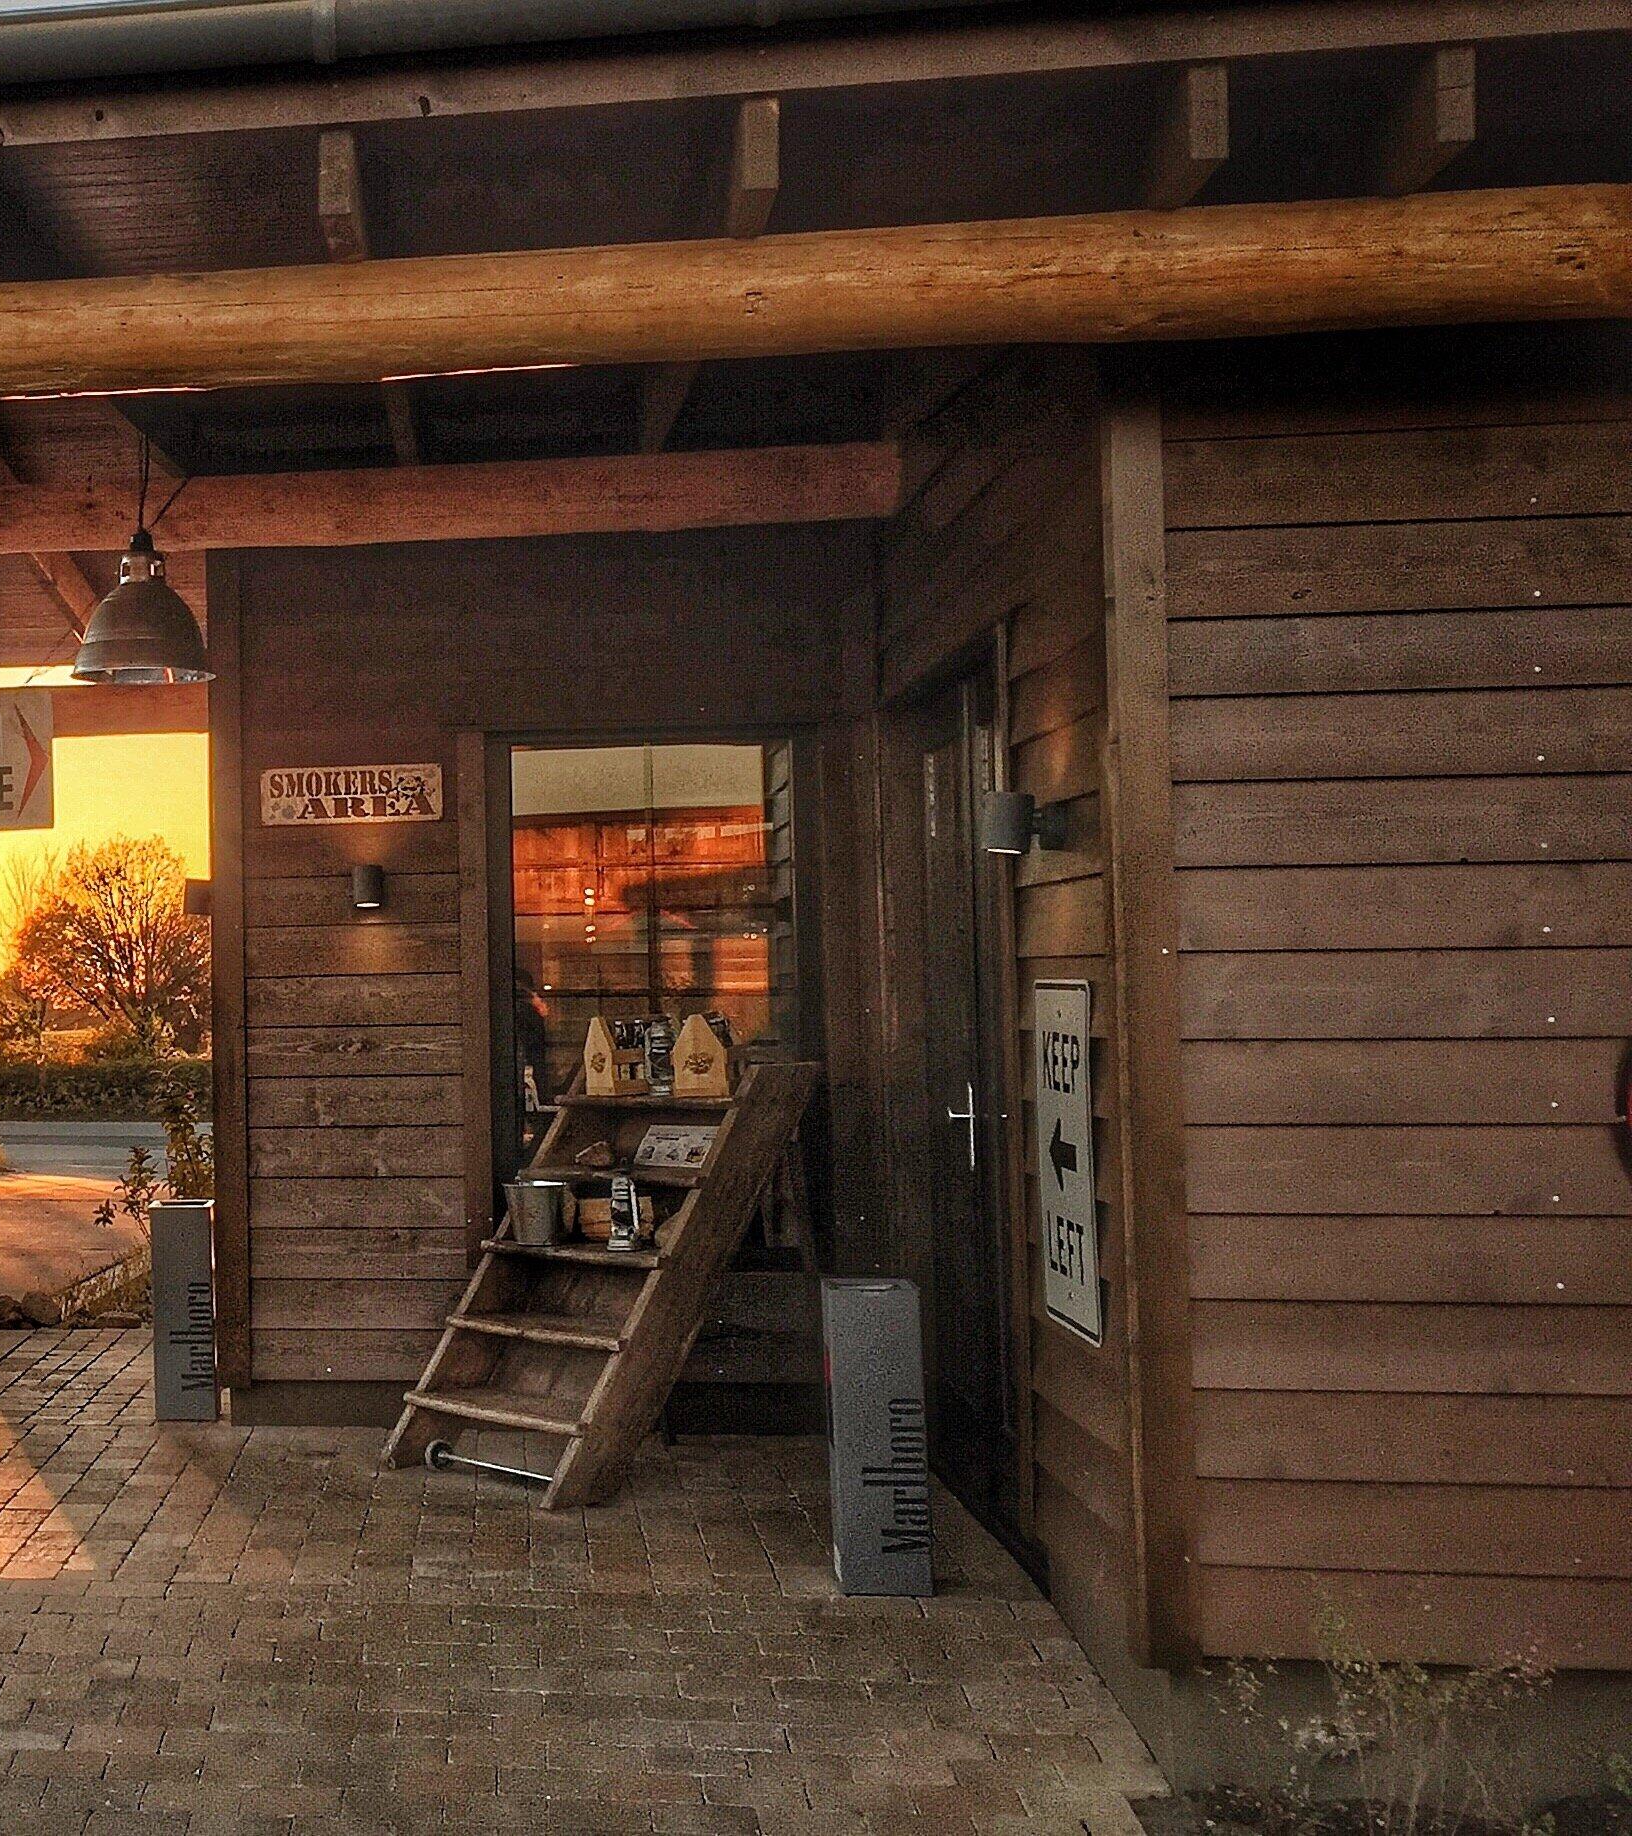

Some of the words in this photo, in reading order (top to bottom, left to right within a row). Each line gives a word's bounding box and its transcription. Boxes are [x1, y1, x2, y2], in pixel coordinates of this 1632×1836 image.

[269, 769, 393, 799] SMOKERS
[297, 794, 437, 819] AREA
[1042, 1030, 1079, 1094] KEEP
[1047, 1209, 1085, 1287] LEFT
[170, 1282, 213, 1392] Marlboro
[862, 1398, 931, 1553] Marlboro
